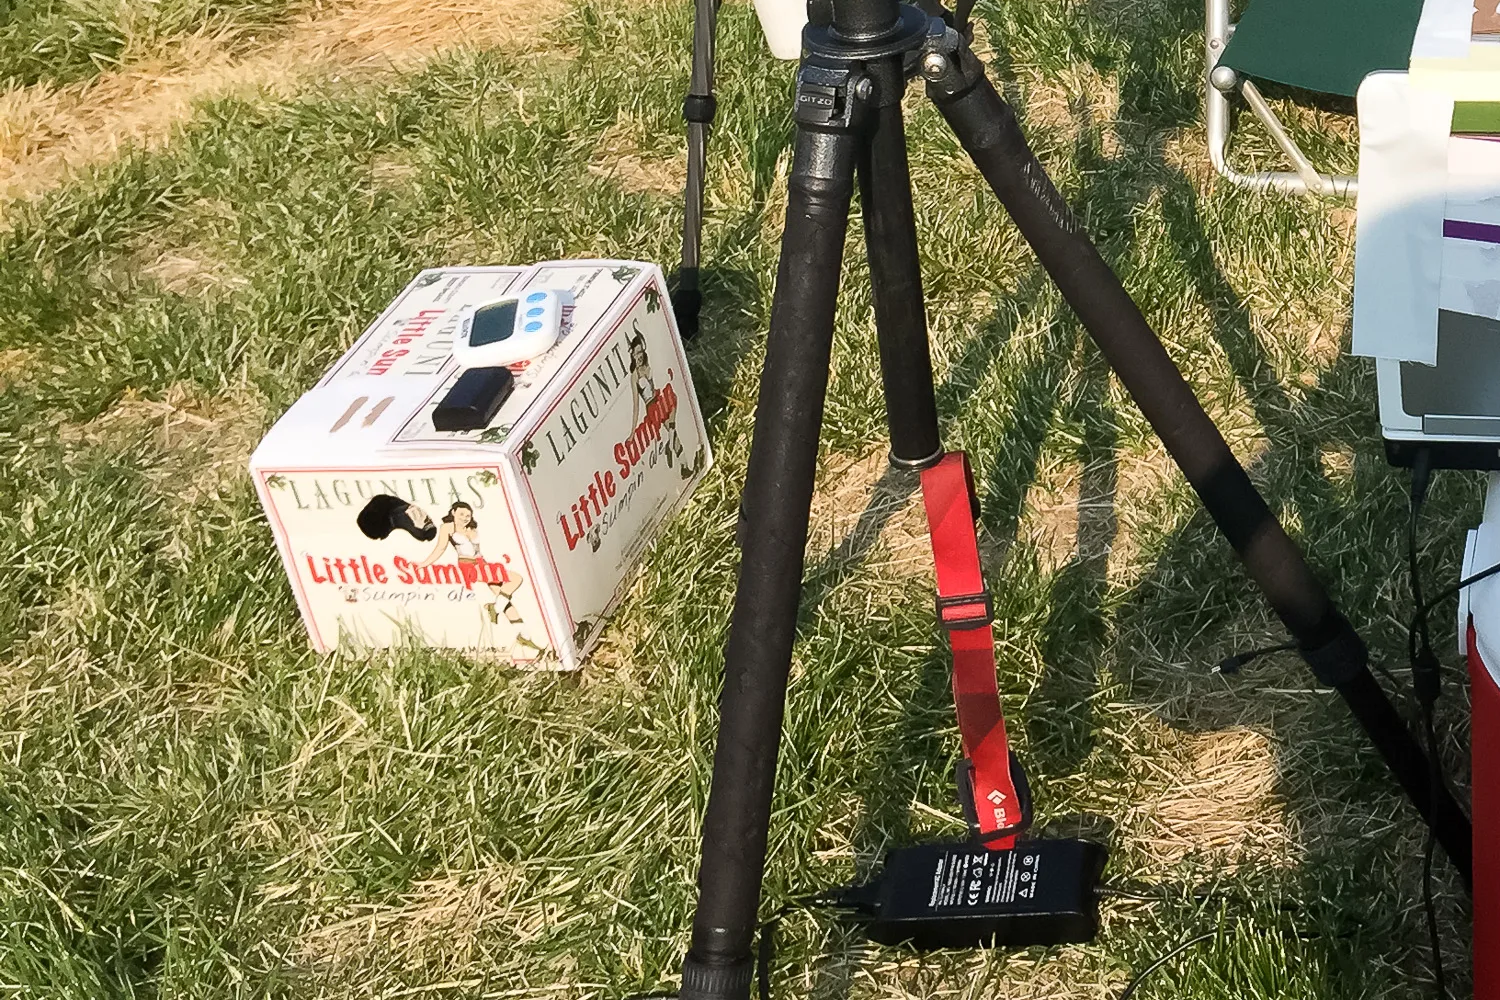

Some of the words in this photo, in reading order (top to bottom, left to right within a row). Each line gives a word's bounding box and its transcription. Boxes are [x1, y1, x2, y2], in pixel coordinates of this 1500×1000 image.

[800, 95, 832, 106] GITZO
[394, 309, 447, 345] Little
[289, 476, 485, 510] LAGUNITAS
[560, 470, 616, 551] Little
[306, 555, 388, 585] Little
